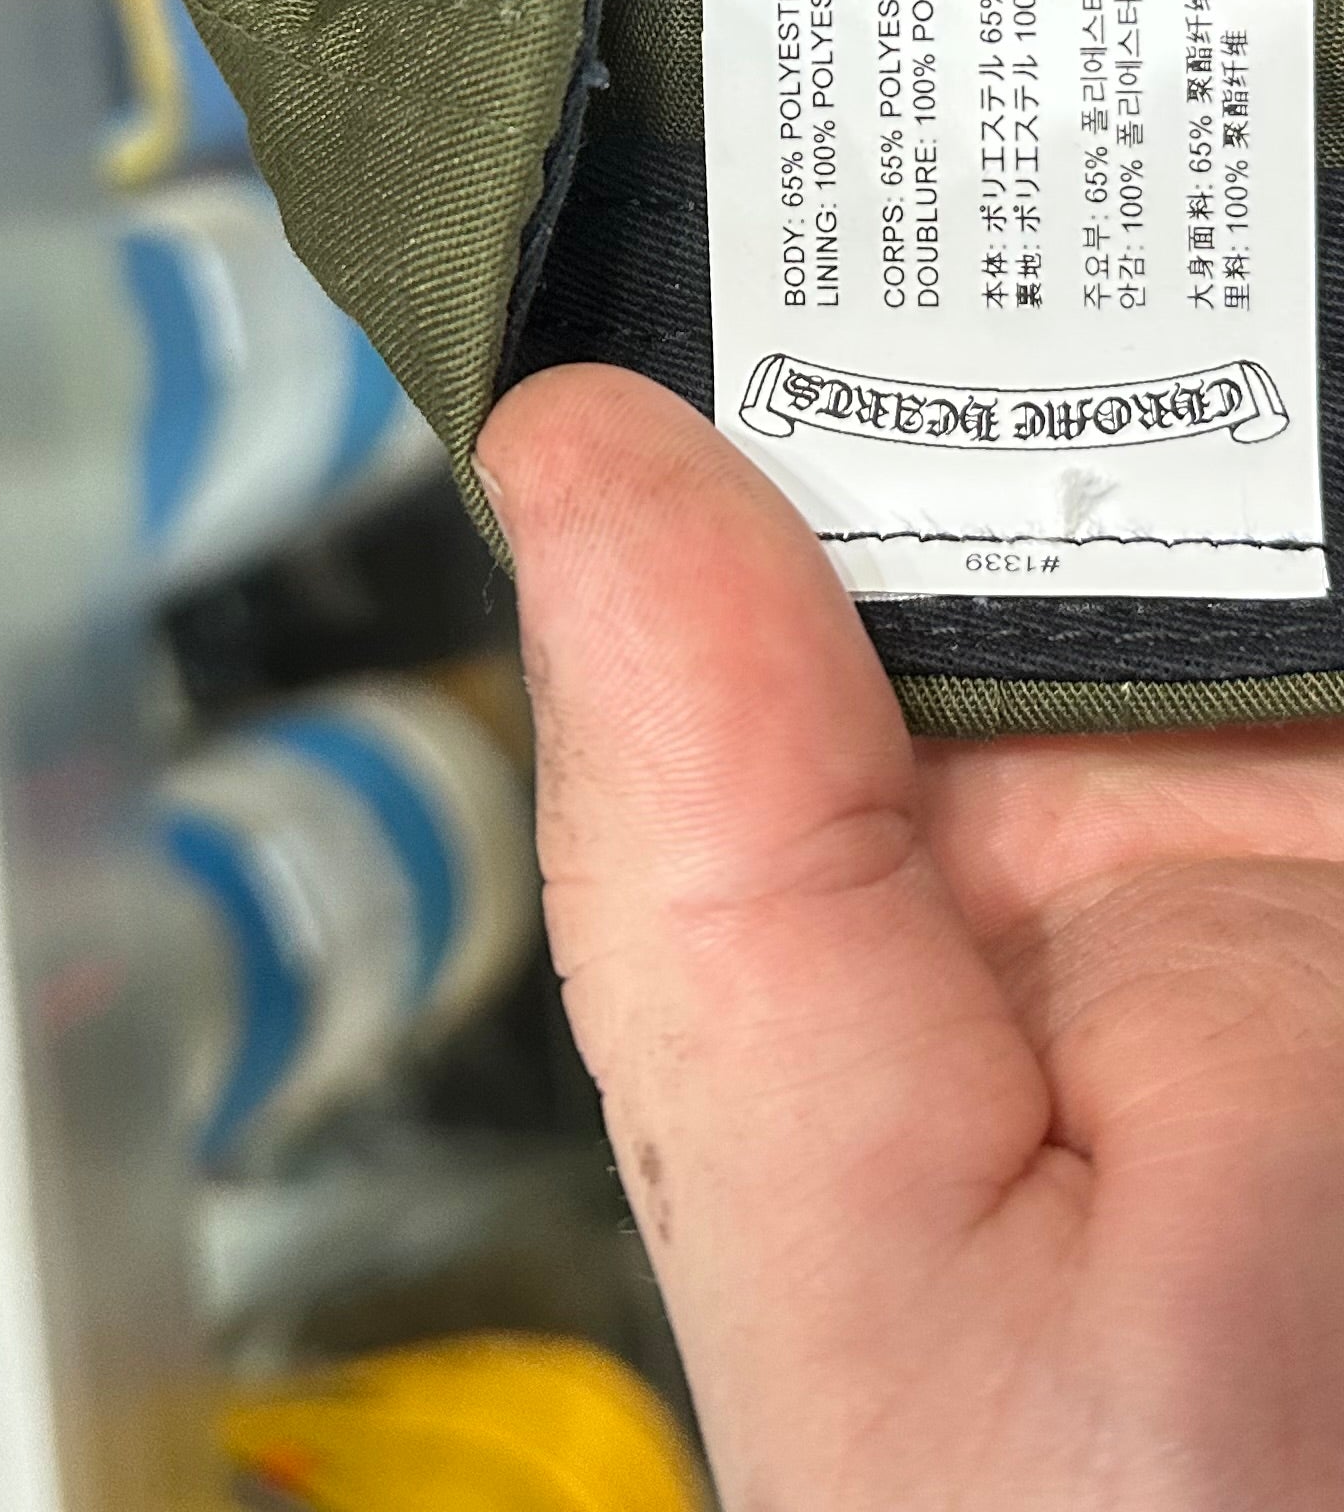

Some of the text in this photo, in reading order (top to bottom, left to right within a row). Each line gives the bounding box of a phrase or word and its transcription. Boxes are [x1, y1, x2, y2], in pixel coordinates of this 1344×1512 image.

[911, 53, 937, 126] 100%
[1219, 29, 1251, 150] 聚酯纤维
[780, 151, 805, 208] 65%
[812, 119, 837, 192] 100%
[879, 129, 905, 187] 65%
[978, 54, 1007, 234] ポリエステル
[1011, 54, 1042, 234] ポリエステル
[1083, 146, 1109, 205] 65%
[1188, 114, 1214, 174] 65%
[914, 138, 940, 308] DOUBLURE:
[1118, 159, 1145, 233] 100%
[1223, 159, 1250, 235] 100%
[782, 218, 807, 307] BODY:
[815, 202, 840, 307] LINING:
[881, 196, 906, 310] CORPS:
[781, 368, 1243, 443] CHROME HEARTS
[965, 553, 1060, 573] #1339
